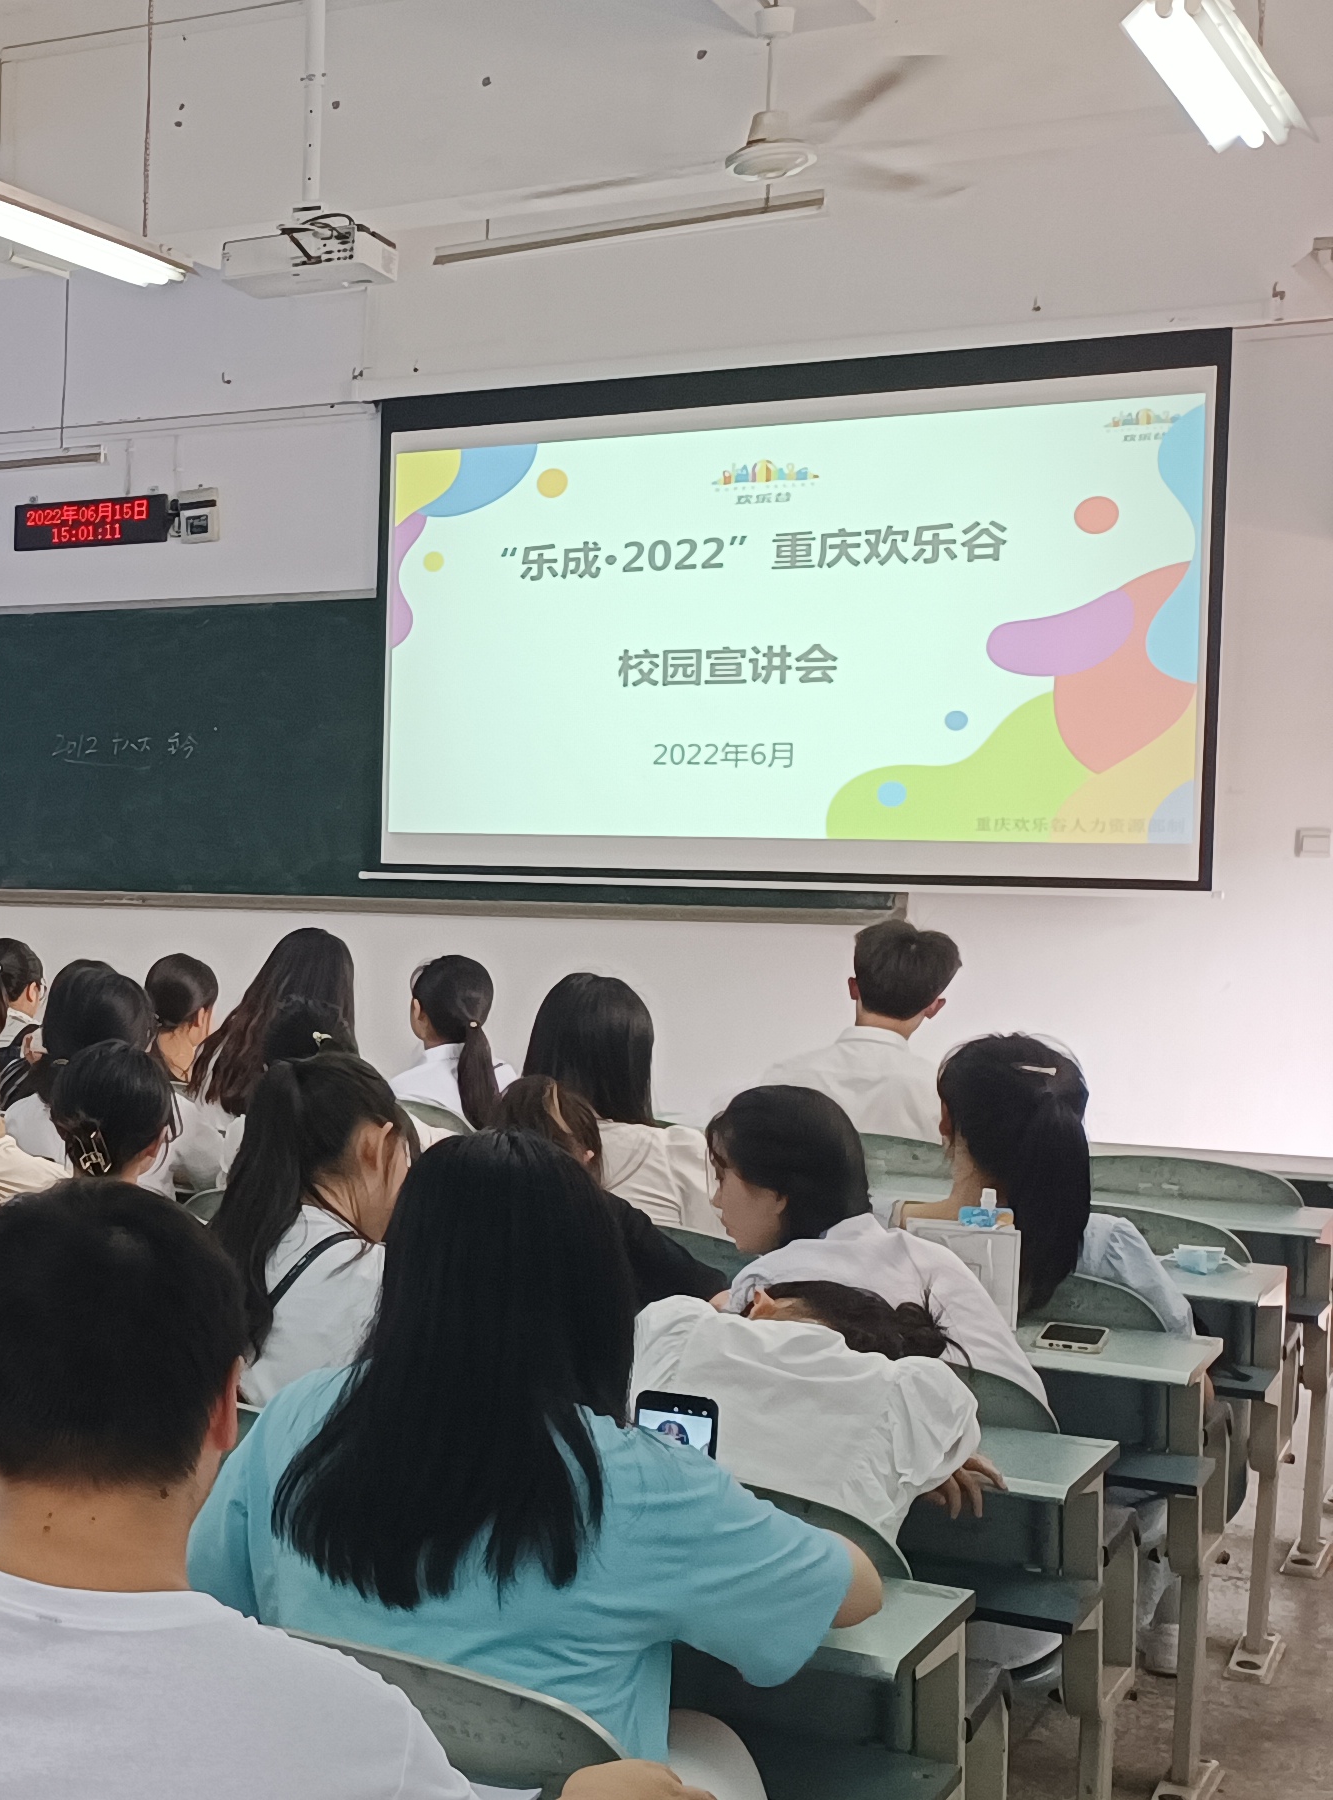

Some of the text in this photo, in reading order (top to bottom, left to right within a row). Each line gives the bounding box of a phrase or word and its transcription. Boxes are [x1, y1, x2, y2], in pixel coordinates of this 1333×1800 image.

[26, 498, 149, 526] 2022年06月15日
[51, 524, 122, 543] 15:01:11
[618, 643, 839, 688] 校园宣讲会
[652, 741, 795, 769] 2022年6月
